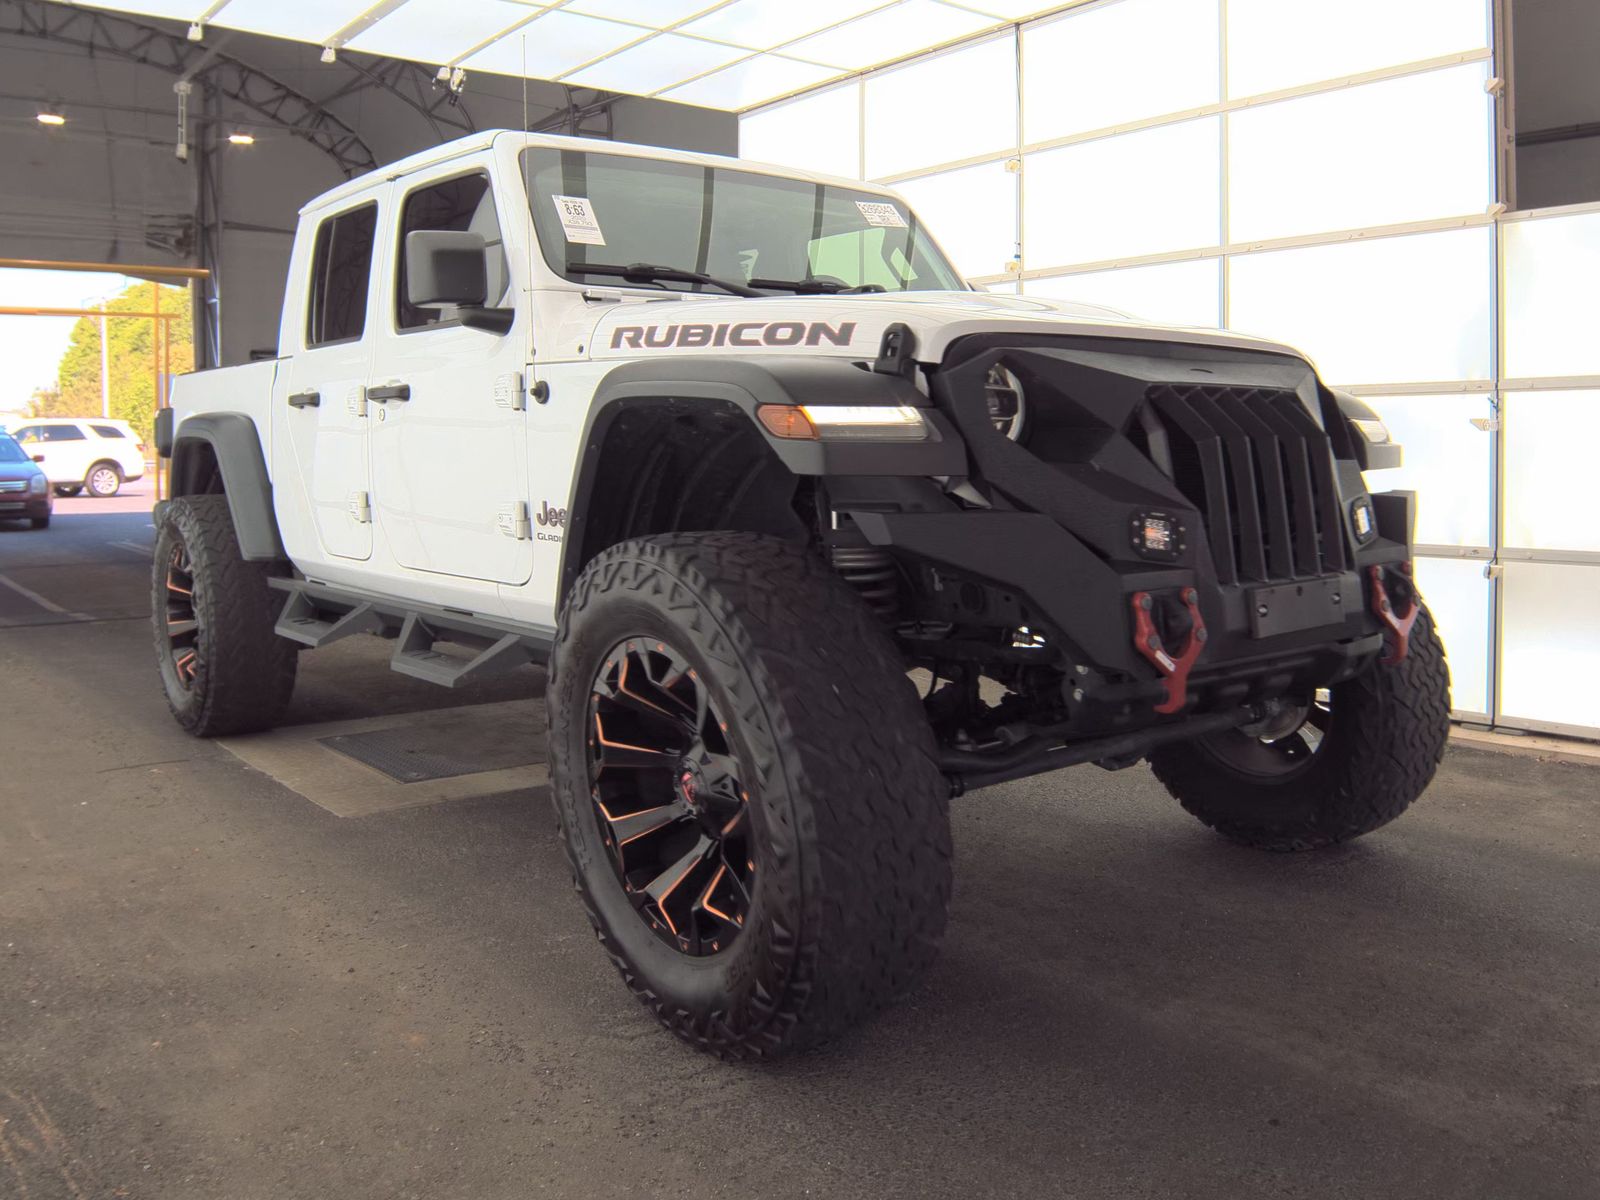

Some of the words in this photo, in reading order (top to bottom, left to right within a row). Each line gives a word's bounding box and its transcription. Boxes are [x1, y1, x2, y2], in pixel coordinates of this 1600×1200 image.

[564, 203, 586, 217] 8:63
[610, 322, 857, 349] RUBICON
[537, 500, 567, 528] Jee
